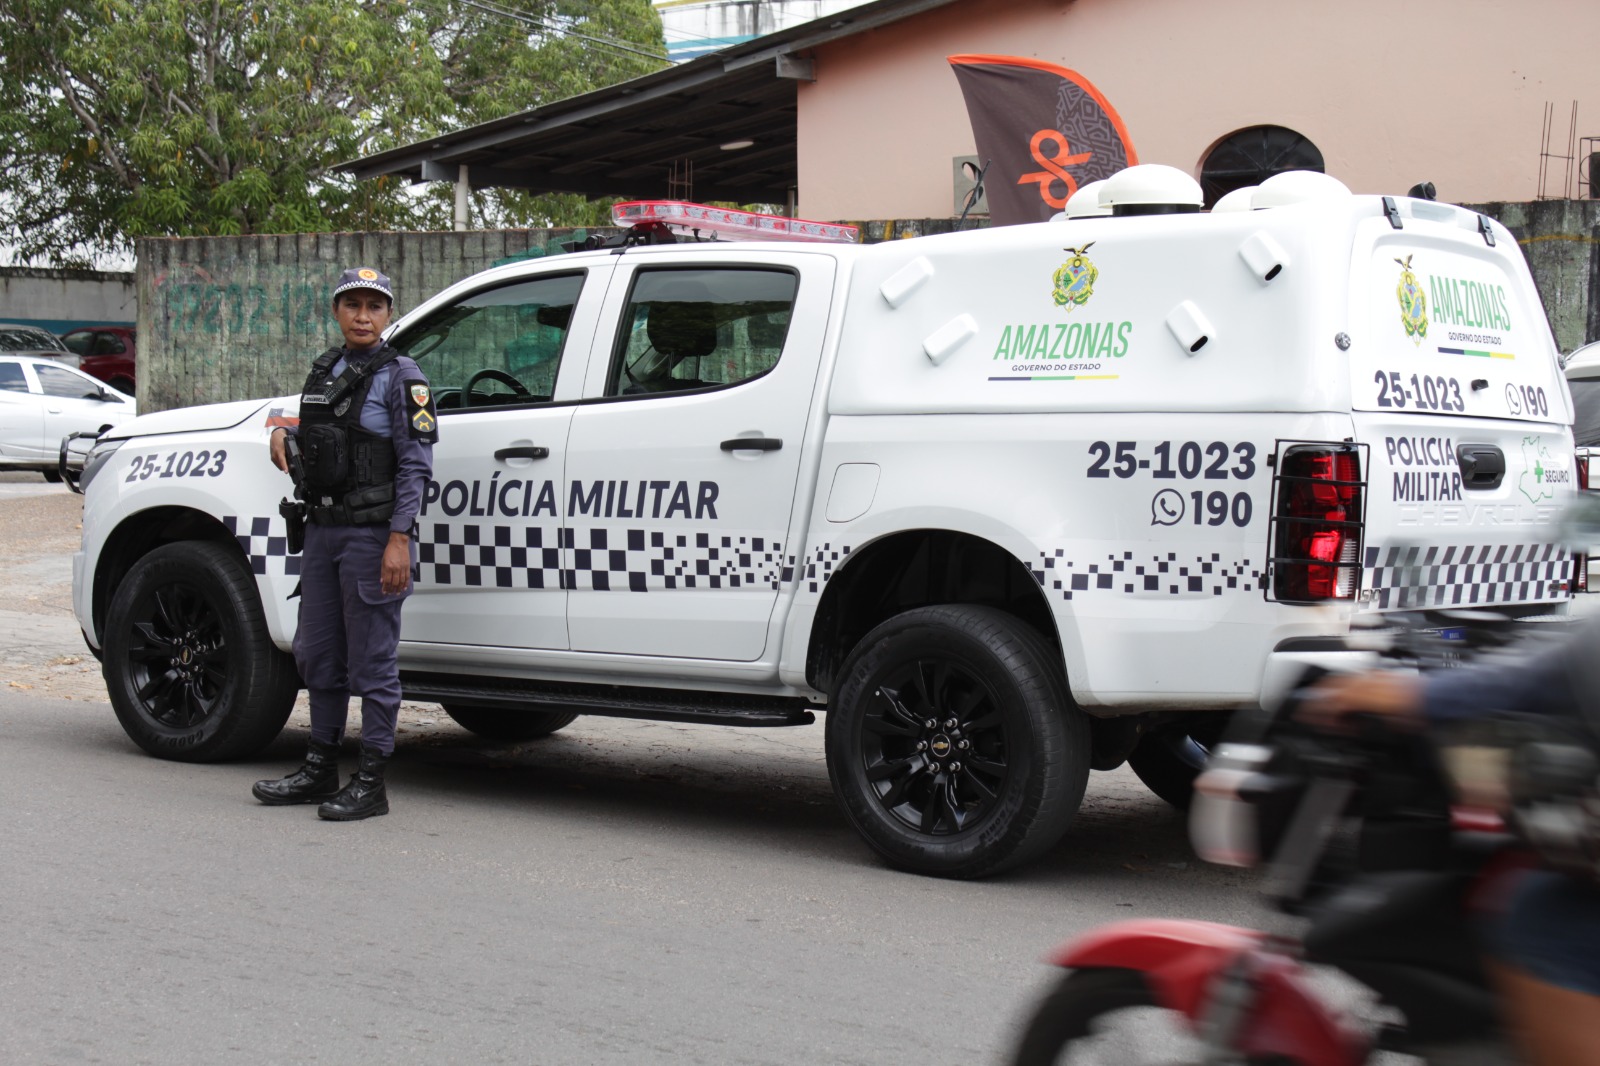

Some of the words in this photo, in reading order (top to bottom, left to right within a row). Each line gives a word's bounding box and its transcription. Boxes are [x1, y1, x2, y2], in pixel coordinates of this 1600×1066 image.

[1429, 274, 1511, 333] AMAZONAS
[993, 320, 1133, 361] AMAZONAS
[1448, 331, 1474, 343] GOVERNO
[1474, 335, 1483, 343] DO
[1483, 335, 1502, 346] ESTADO
[1011, 364, 1053, 372] GOVERNO
[1068, 363, 1102, 371] ESTADO
[1374, 369, 1465, 413] 25-1023
[1520, 384, 1549, 418] 190
[126, 449, 228, 483] 25-1023
[1086, 441, 1257, 480] 25-1023
[1544, 470, 1570, 484] SEGURO
[420, 471, 558, 517] POLÍCIA
[567, 480, 720, 520] MILITAR
[1393, 471, 1462, 502] MILITAR
[1190, 490, 1254, 528] 190
